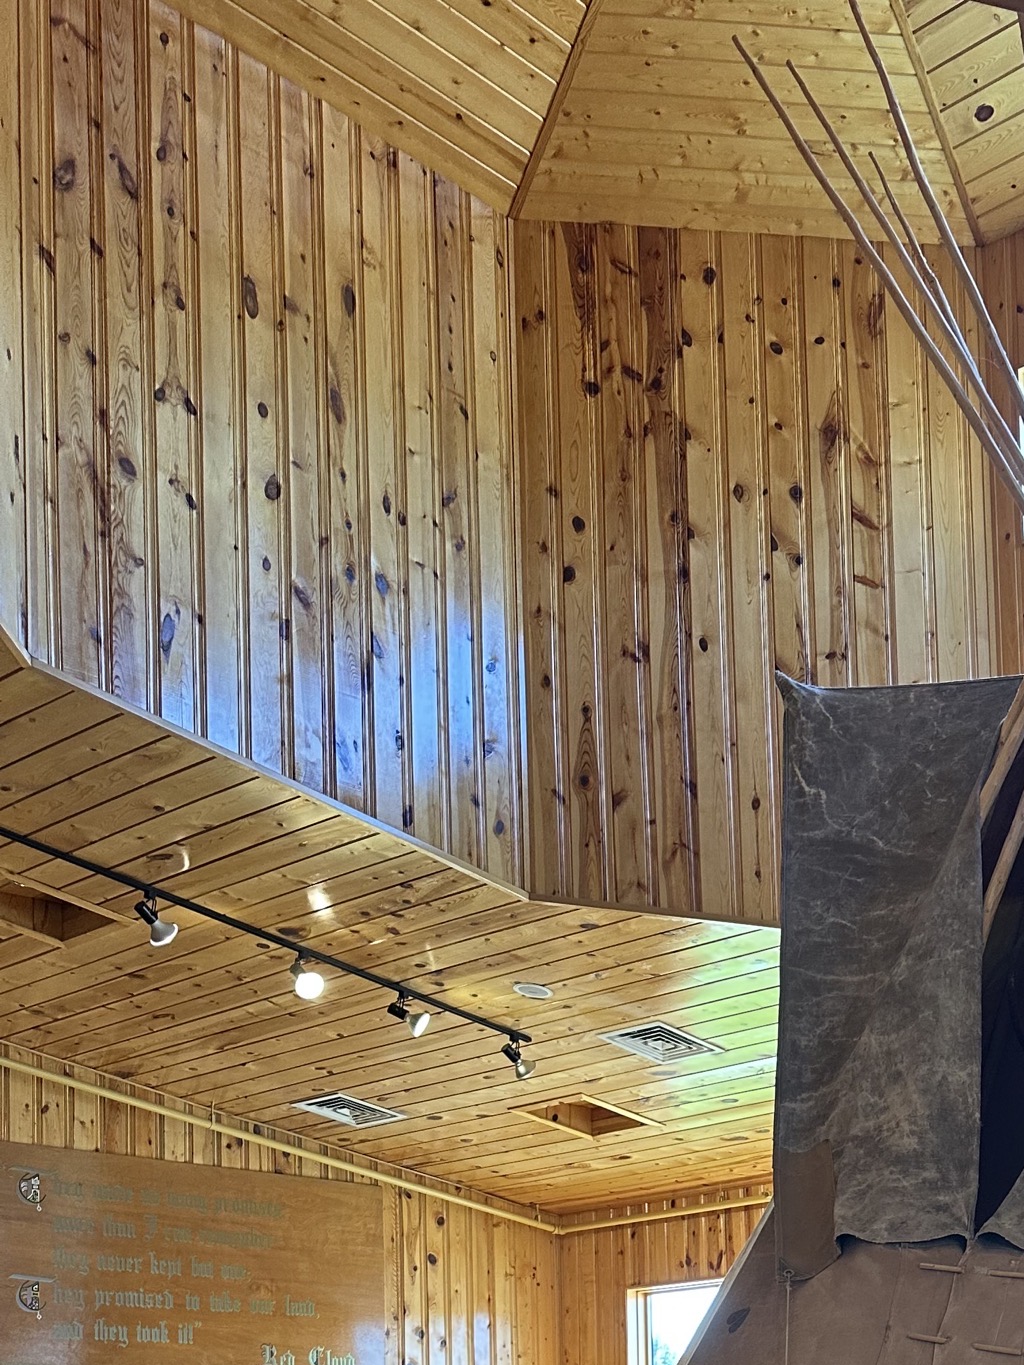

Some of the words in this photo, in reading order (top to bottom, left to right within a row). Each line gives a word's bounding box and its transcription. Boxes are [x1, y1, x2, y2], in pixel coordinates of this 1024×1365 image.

[97, 1254, 143, 1274] never
[149, 1252, 182, 1279] kept
[191, 1256, 214, 1279] but
[94, 1288, 174, 1311] promised
[185, 1291, 200, 1312] to
[210, 1290, 241, 1313] take
[94, 1317, 129, 1348] they
[136, 1320, 170, 1344] took
